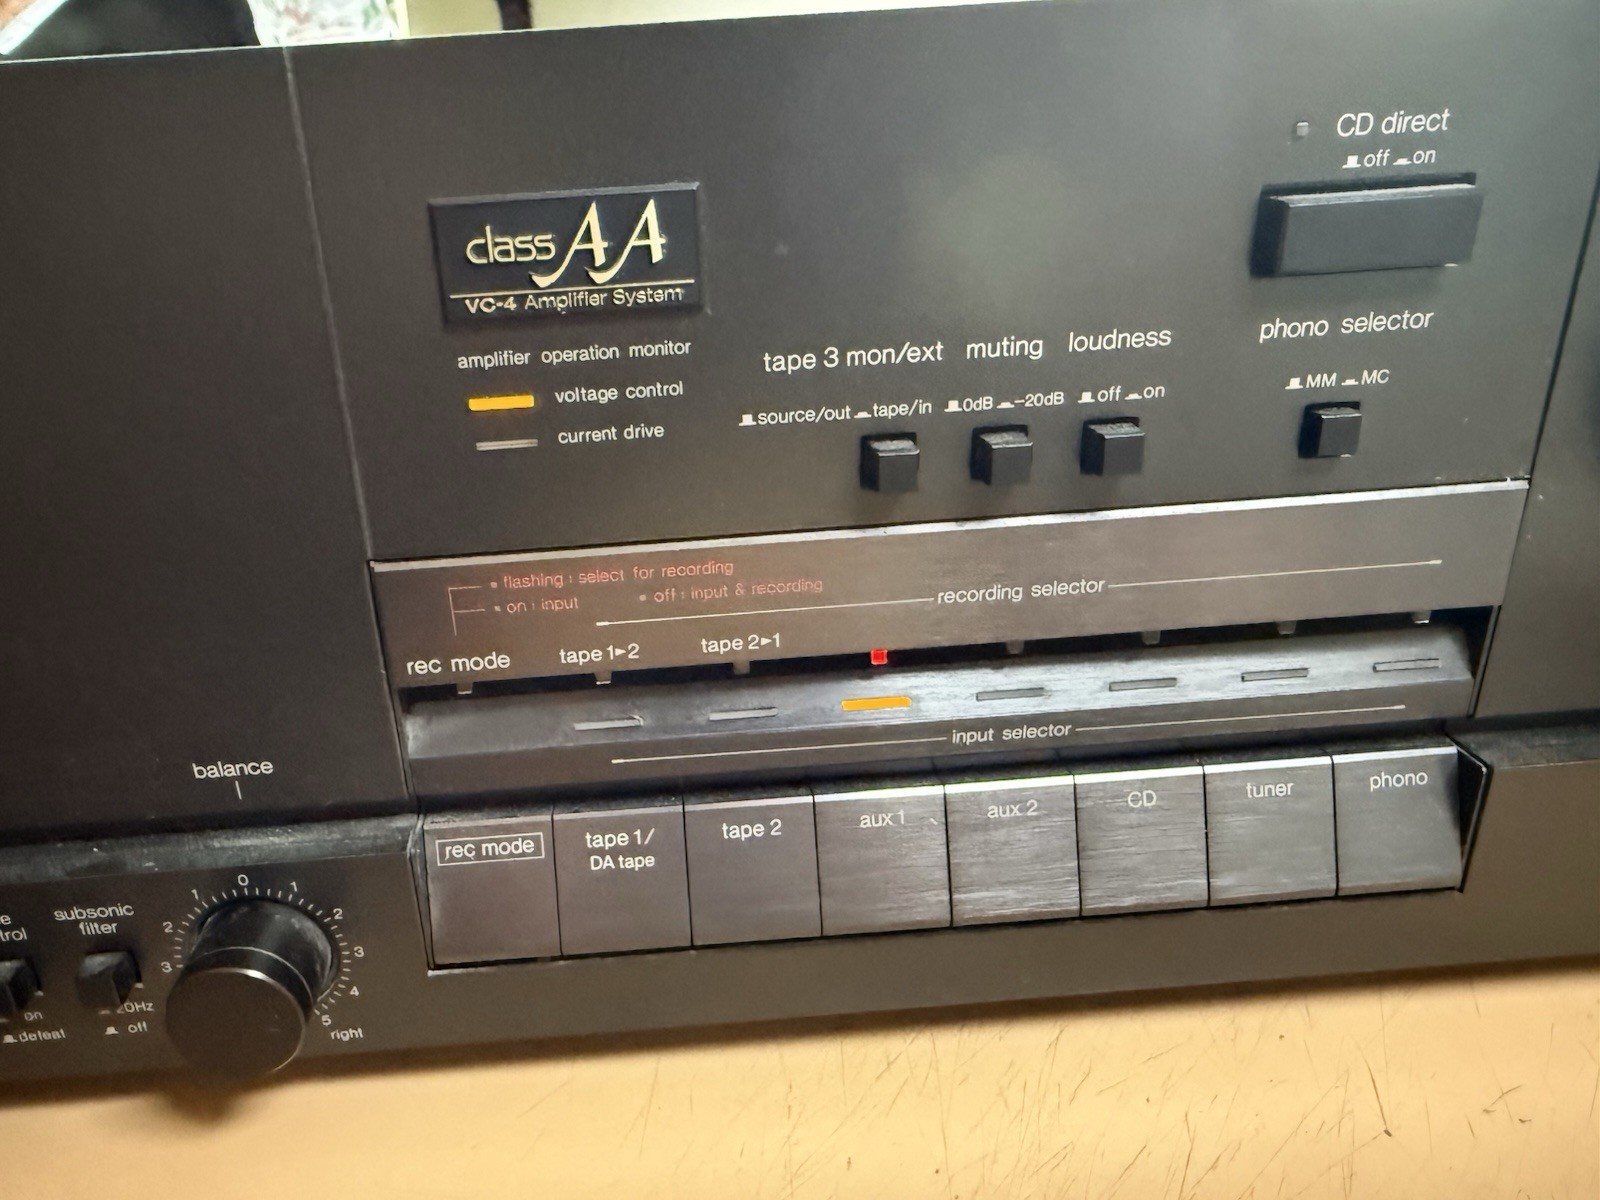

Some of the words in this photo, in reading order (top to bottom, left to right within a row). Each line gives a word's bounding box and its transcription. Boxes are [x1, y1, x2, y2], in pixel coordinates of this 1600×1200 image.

[1337, 112, 1373, 137] CD
[1381, 108, 1450, 132] direct
[1364, 150, 1390, 168] off
[1413, 150, 1436, 164] on
[466, 225, 556, 264] class
[465, 296, 516, 314] VC-4
[525, 292, 608, 315] Amplifier
[612, 287, 684, 307] System
[1259, 319, 1329, 343] phono
[1341, 310, 1434, 334] selector
[966, 335, 1044, 360] muting
[1068, 328, 1172, 353] loudness
[457, 351, 531, 371] amplifier
[541, 344, 619, 366] operation
[629, 340, 691, 358] monitor
[763, 350, 817, 374] tape
[823, 347, 839, 367] 3
[846, 341, 944, 366] mon/ext
[1306, 374, 1337, 388] MM
[1361, 369, 1390, 384] MC
[554, 386, 618, 405] voltage
[625, 381, 684, 398] control
[1097, 386, 1121, 402] off
[1143, 384, 1166, 399] on
[757, 404, 851, 426] source/out
[872, 398, 932, 420] tape/in
[963, 396, 993, 412] 0dB
[557, 427, 617, 445] current
[624, 424, 665, 441] drive
[503, 573, 565, 589] flashing
[578, 569, 625, 584] select
[633, 566, 654, 580] for
[661, 560, 735, 578] recording
[653, 588, 676, 603] off
[691, 584, 729, 602] input
[735, 582, 746, 597] &
[751, 579, 823, 594] recording
[937, 583, 1023, 604] recording
[1030, 577, 1106, 597] selector
[506, 602, 528, 614] on
[541, 597, 579, 612] input
[700, 637, 743, 655] tape
[406, 659, 442, 676] rec
[450, 651, 511, 673] mode
[559, 648, 603, 666] tape
[952, 729, 994, 745] input
[1002, 722, 1072, 740] selector
[192, 760, 274, 780] balance
[1246, 782, 1294, 799] tuner
[1369, 770, 1429, 792] phono
[1127, 790, 1157, 808] CD
[987, 803, 1020, 819] aux
[1023, 799, 1039, 816] 2
[721, 823, 764, 841] tape
[769, 818, 783, 836] 2
[859, 812, 894, 829] aux
[444, 842, 476, 861] rec
[481, 836, 535, 857] mode
[585, 832, 630, 852] tape
[634, 826, 655, 847] 1/
[590, 856, 616, 871] DA
[618, 852, 656, 871] tape
[237, 874, 249, 886] 0
[290, 881, 299, 893] 1
[191, 889, 200, 900] 1
[53, 904, 135, 922] subsonic
[333, 908, 344, 920] 2
[78, 922, 118, 936] filter
[163, 921, 174, 933] 2
[353, 946, 365, 958] 3
[160, 961, 173, 974] 3
[349, 985, 360, 997] 4
[321, 1015, 332, 1027] 5
[330, 1027, 364, 1042] right
